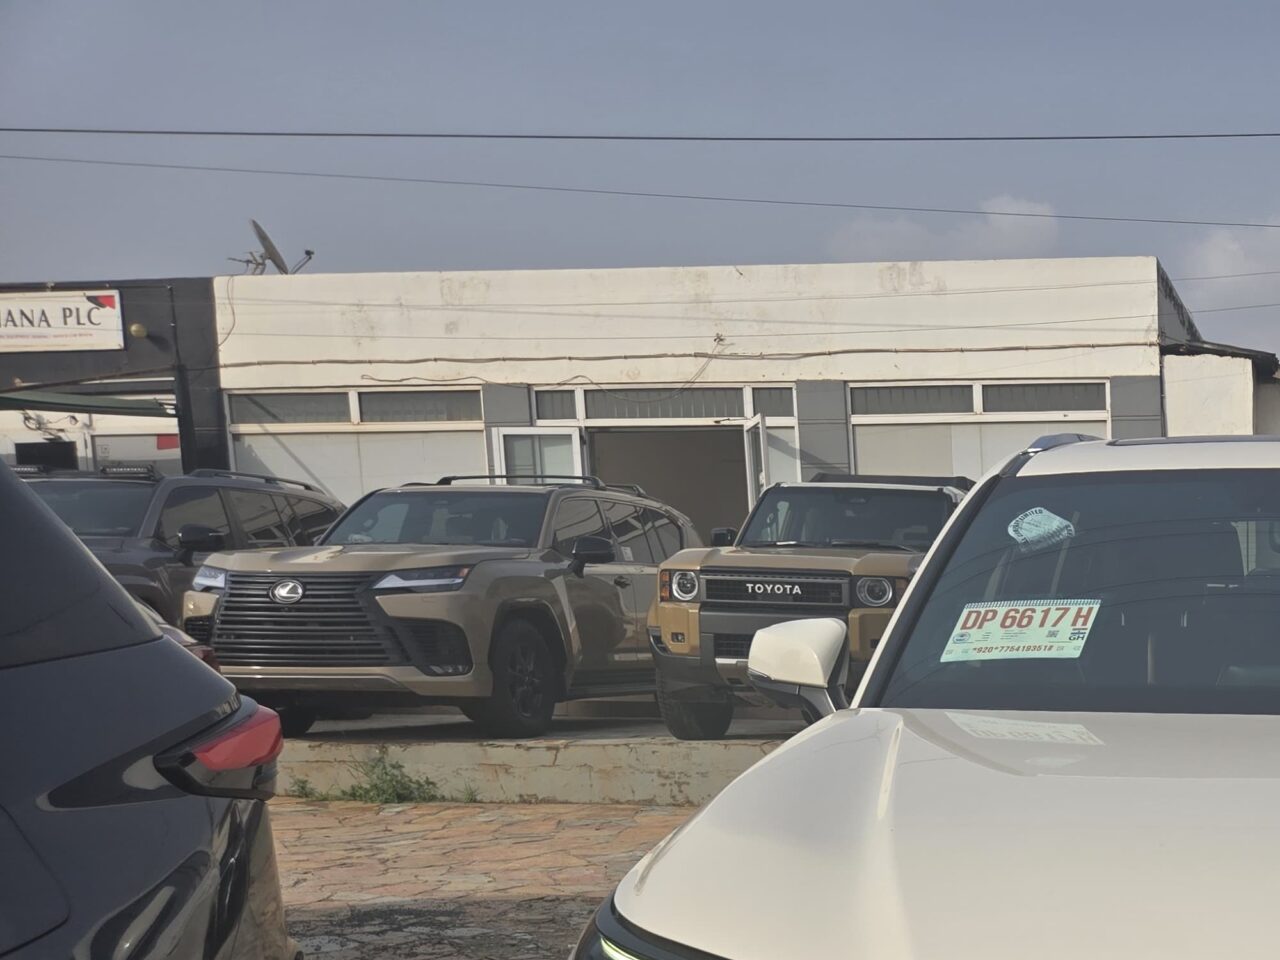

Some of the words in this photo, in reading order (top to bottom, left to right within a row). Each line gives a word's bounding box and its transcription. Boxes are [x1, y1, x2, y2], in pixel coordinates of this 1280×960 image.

[0, 308, 51, 328] ANA
[62, 307, 102, 326] PLC
[745, 583, 802, 595] TOYOTA
[960, 609, 998, 630] DP
[999, 607, 1071, 629] 6617
[1070, 606, 1094, 627] H
